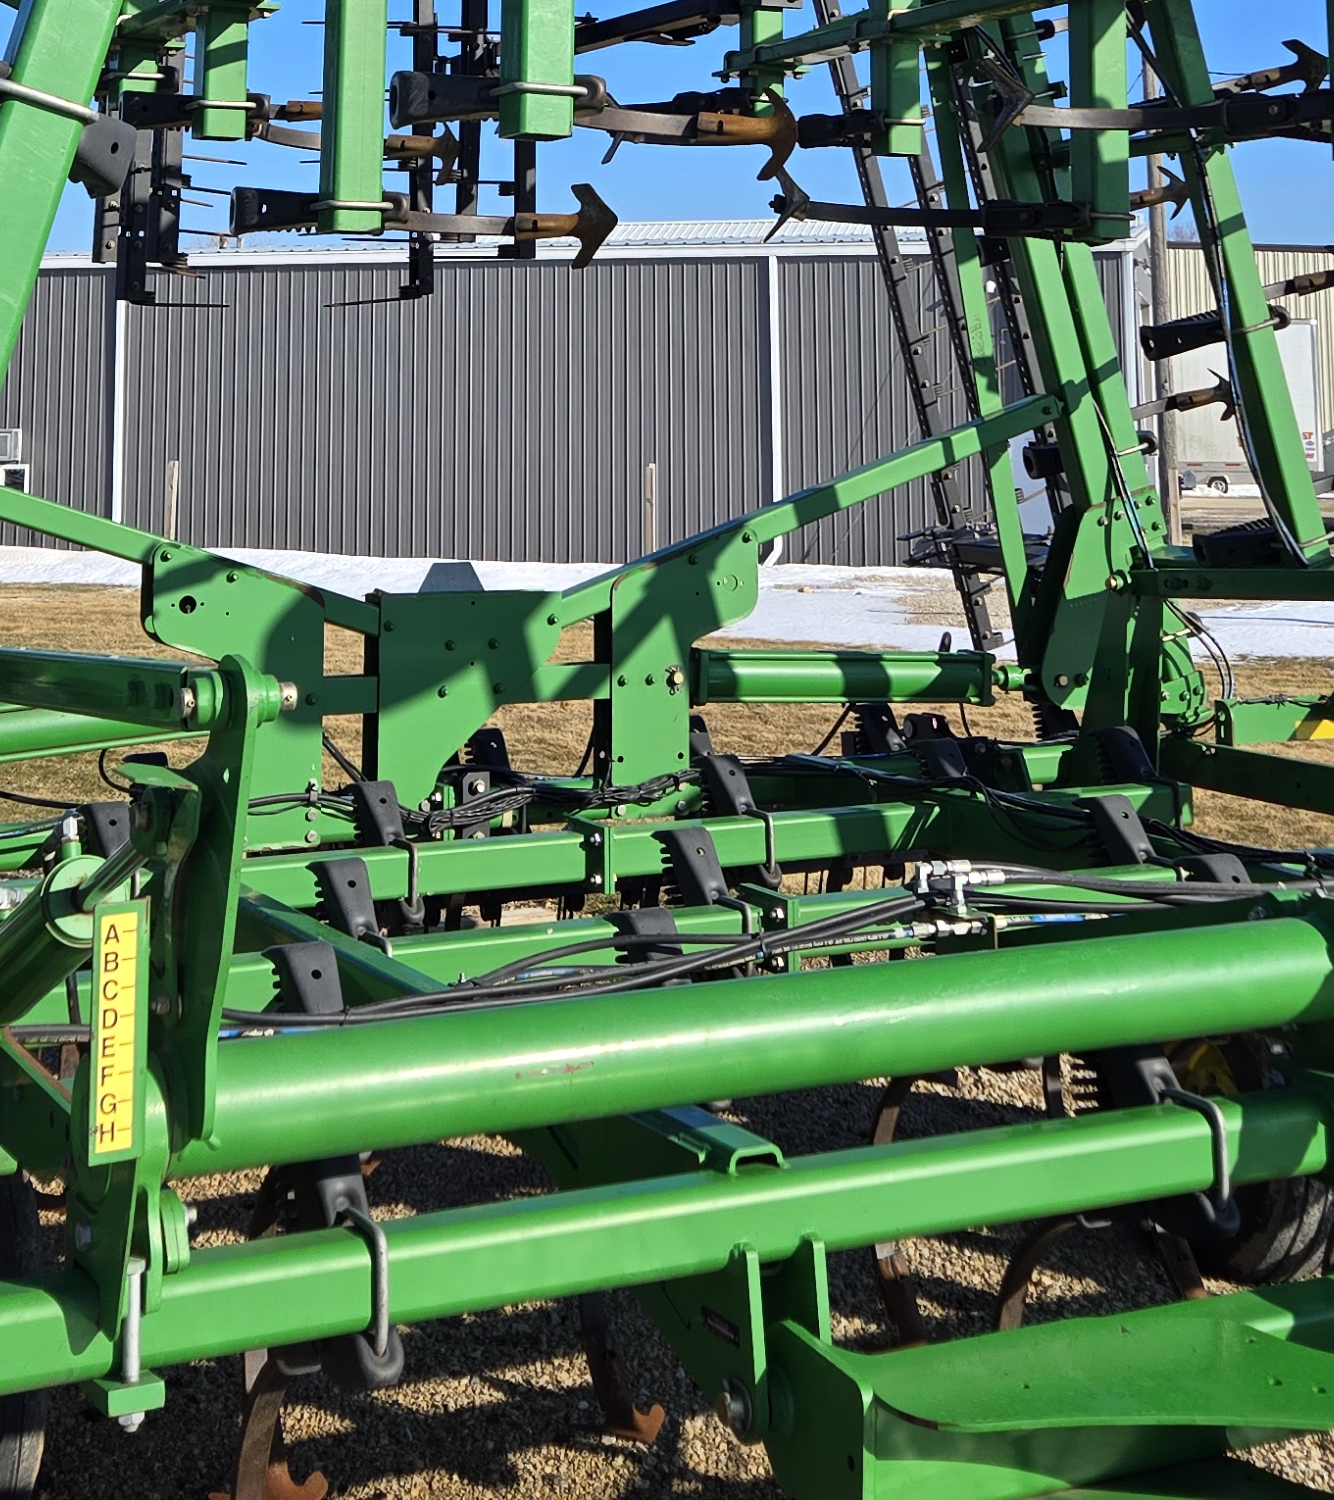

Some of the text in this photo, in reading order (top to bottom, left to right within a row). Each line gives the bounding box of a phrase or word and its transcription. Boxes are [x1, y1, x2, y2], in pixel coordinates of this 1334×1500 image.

[104, 924, 120, 945] A
[104, 952, 118, 973] B
[103, 979, 118, 1001] C
[102, 1008, 118, 1030] D
[101, 1036, 116, 1059] E
[100, 1064, 115, 1087] F
[100, 1093, 117, 1115] G
[99, 1121, 115, 1145] H
